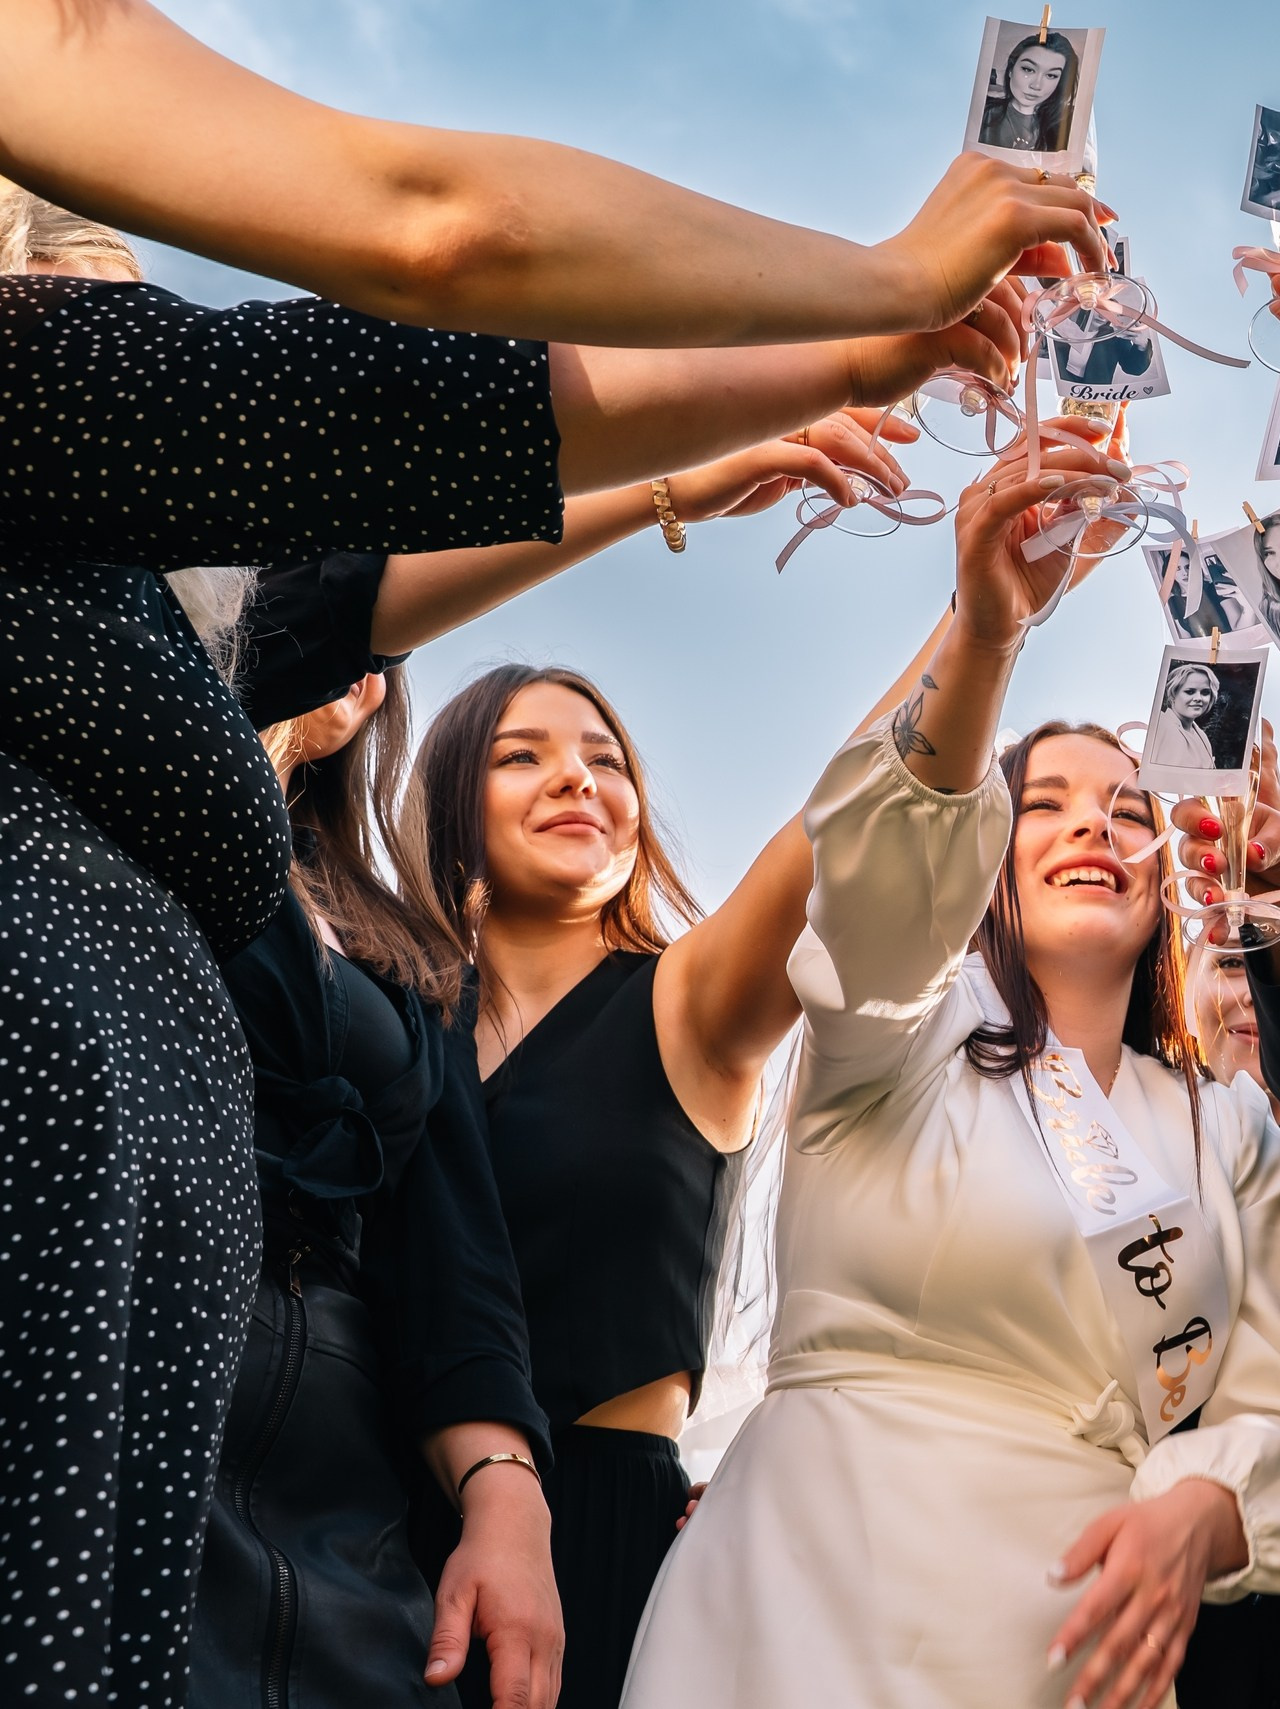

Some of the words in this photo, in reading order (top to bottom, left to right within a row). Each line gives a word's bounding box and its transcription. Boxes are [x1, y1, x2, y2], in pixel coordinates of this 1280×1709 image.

[1070, 385, 1139, 400] Bride
[1028, 1054, 1138, 1216] Bride
[1118, 1214, 1183, 1310] to
[1152, 1316, 1213, 1422] Be
